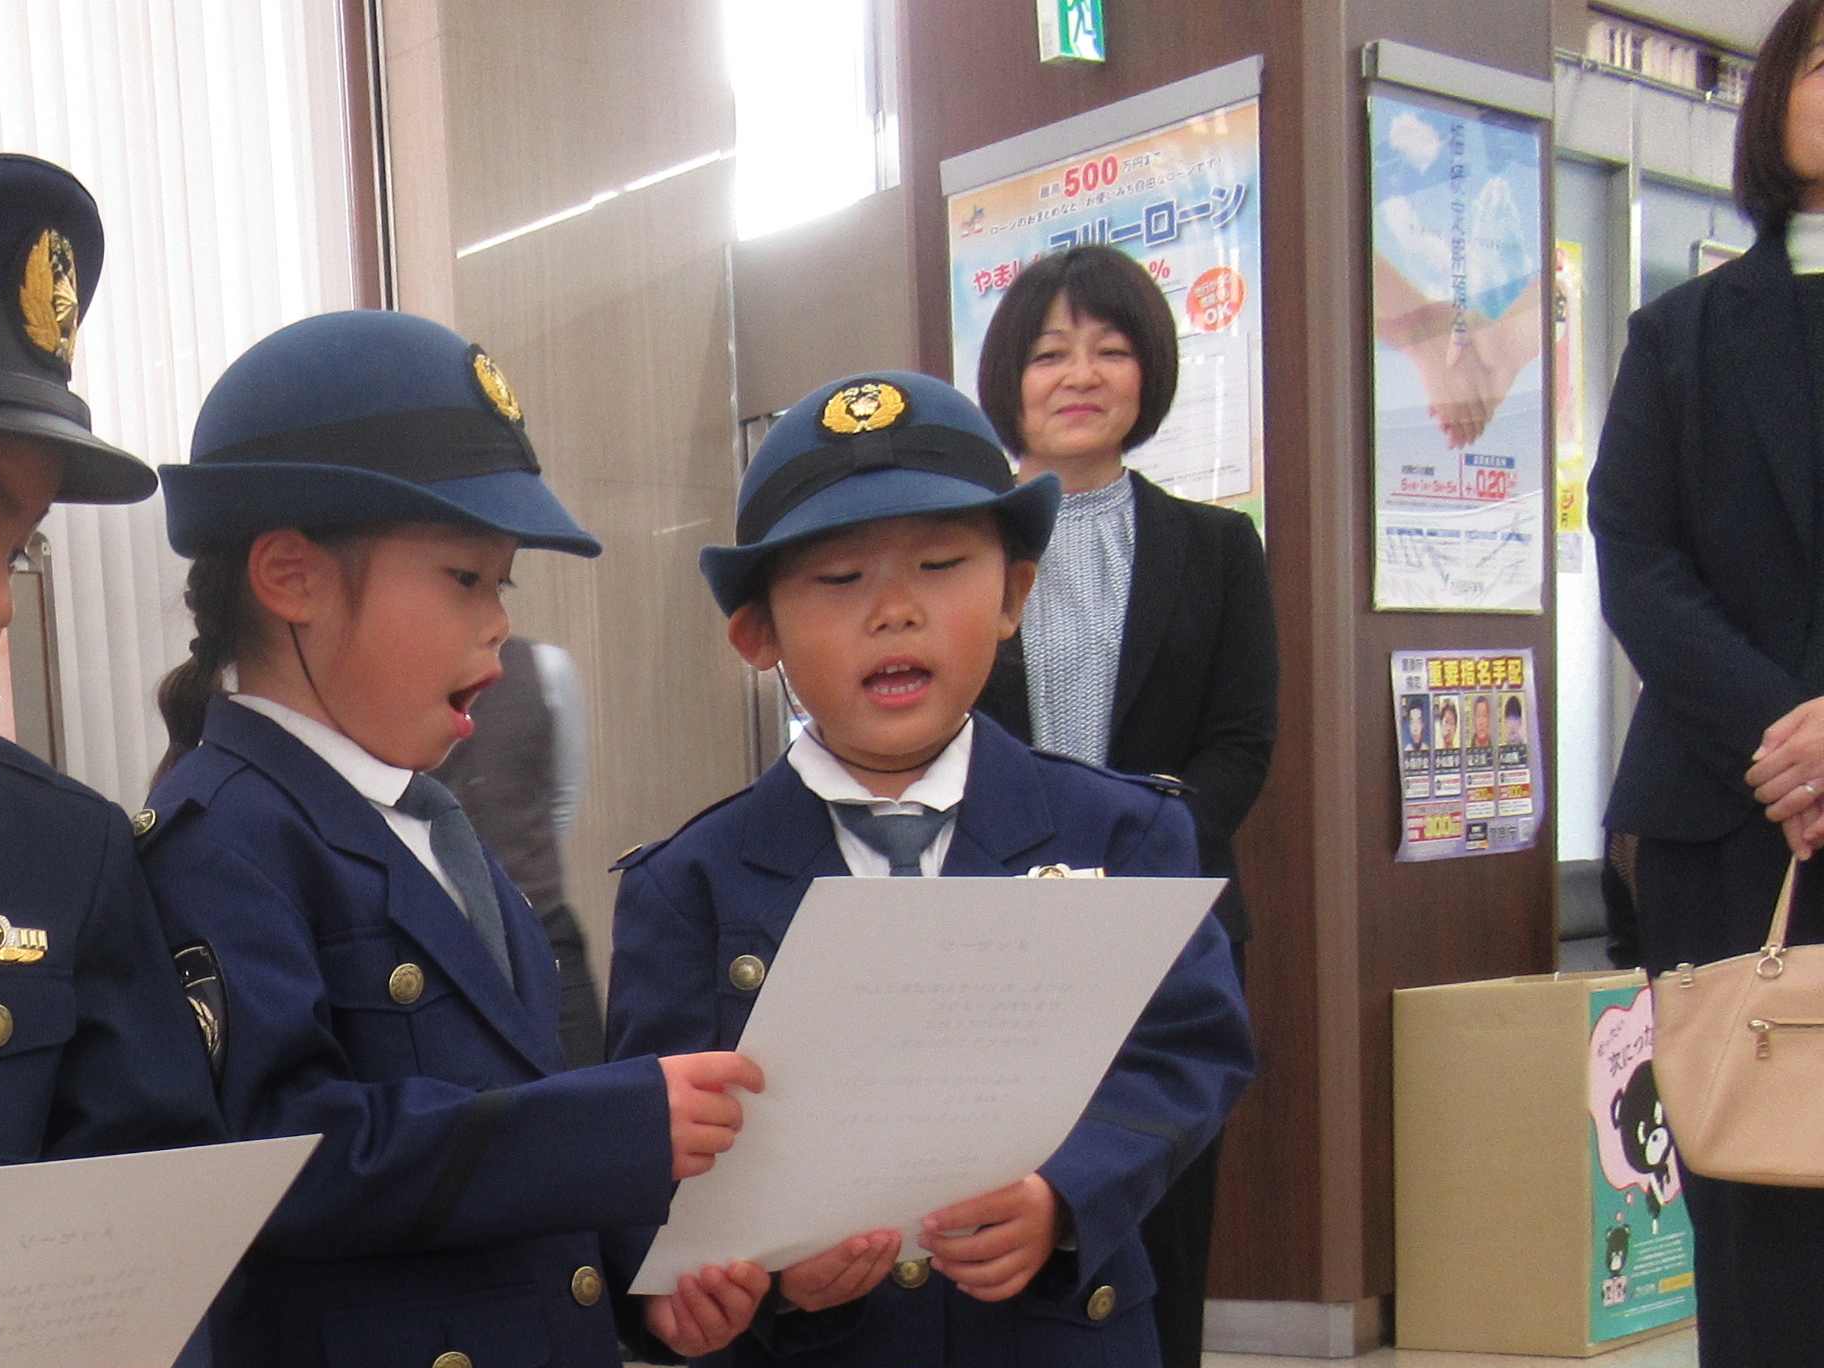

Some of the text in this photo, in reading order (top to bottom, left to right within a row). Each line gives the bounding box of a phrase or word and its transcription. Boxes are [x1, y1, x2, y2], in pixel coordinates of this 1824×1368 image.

[972, 252, 1042, 294] やまし
[1204, 301, 1231, 325] OK
[1427, 656, 1524, 691] 重要指名手配
